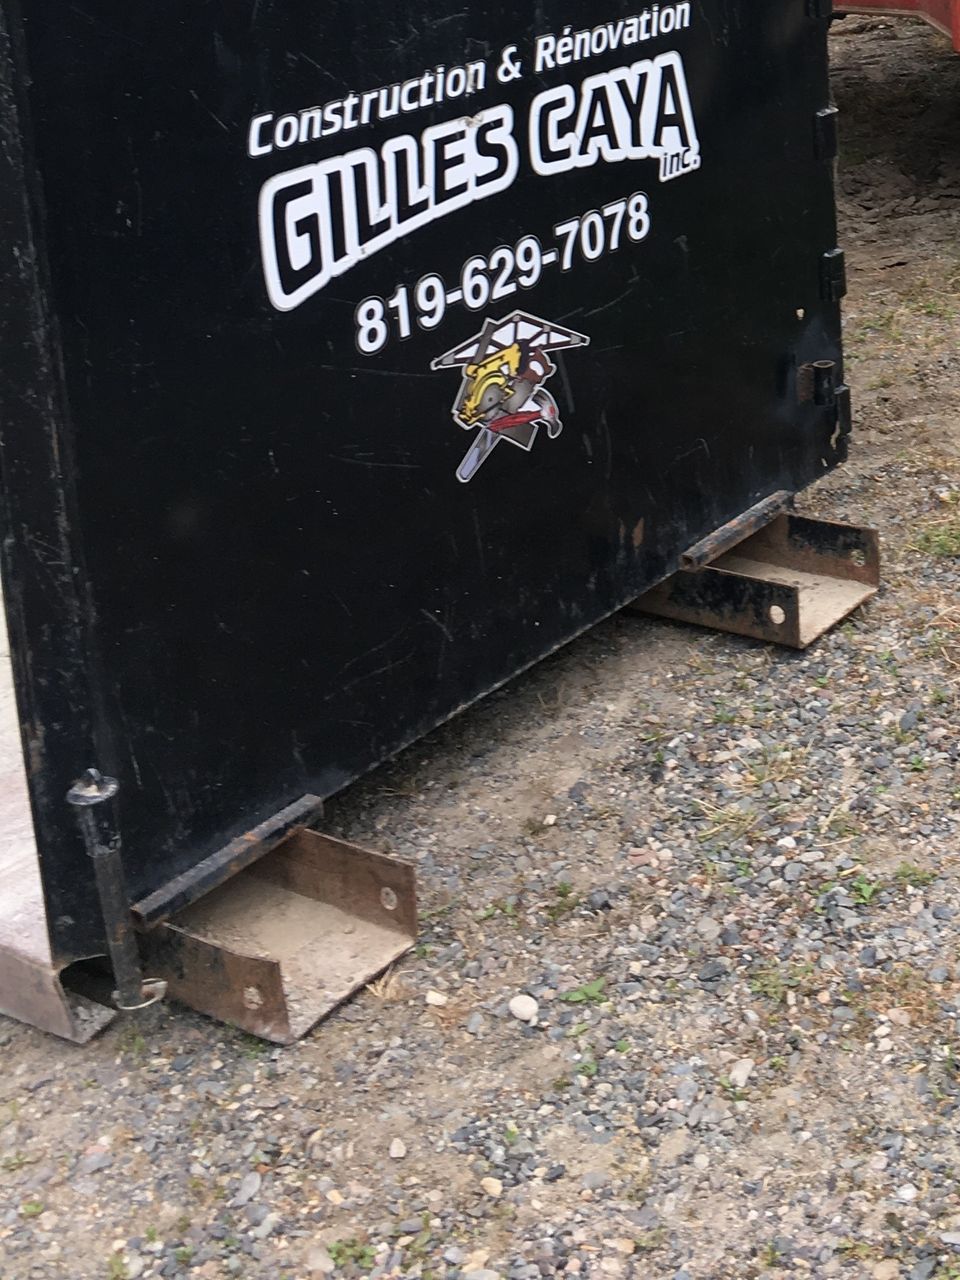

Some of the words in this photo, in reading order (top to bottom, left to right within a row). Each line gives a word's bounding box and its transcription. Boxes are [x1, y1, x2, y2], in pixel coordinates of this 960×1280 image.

[247, 58, 486, 158] Construction
[496, 45, 522, 84] &
[534, 0, 692, 75] Rénovation
[658, 138, 701, 182] inc.
[258, 102, 519, 312] GILLES
[529, 50, 697, 177] CAYA
[355, 190, 652, 357] 819-629-7078
